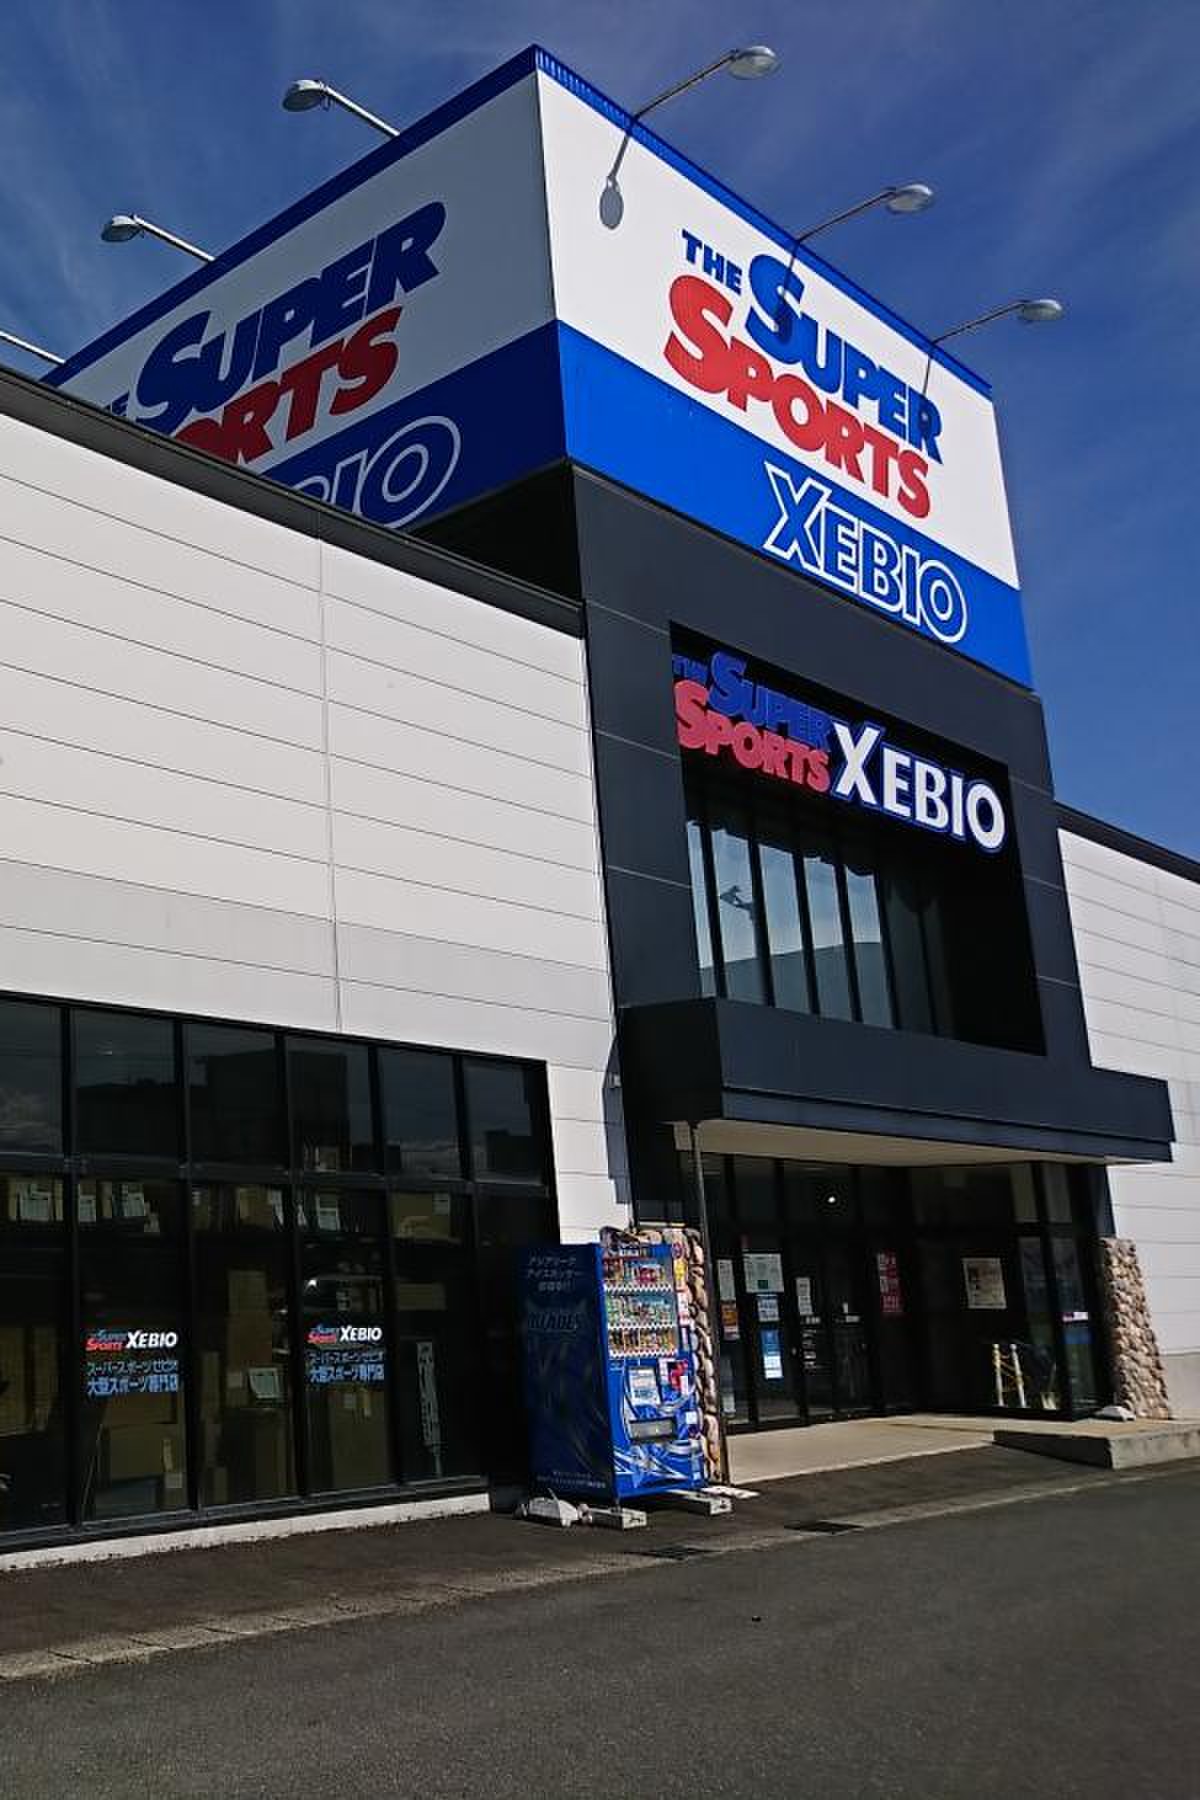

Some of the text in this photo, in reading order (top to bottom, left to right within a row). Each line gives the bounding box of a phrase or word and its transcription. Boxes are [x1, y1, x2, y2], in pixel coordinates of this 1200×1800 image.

[135, 201, 447, 433] SUPER
[682, 229, 944, 464] THE SUPER
[664, 274, 931, 519] SPORTS
[764, 461, 967, 644] XEBIO
[673, 679, 831, 793] SPORTS
[707, 650, 833, 751] SUPER
[832, 721, 1006, 851] XEBIO
[126, 1329, 178, 1349] XEBIO
[339, 1325, 383, 1342] XEBIO
